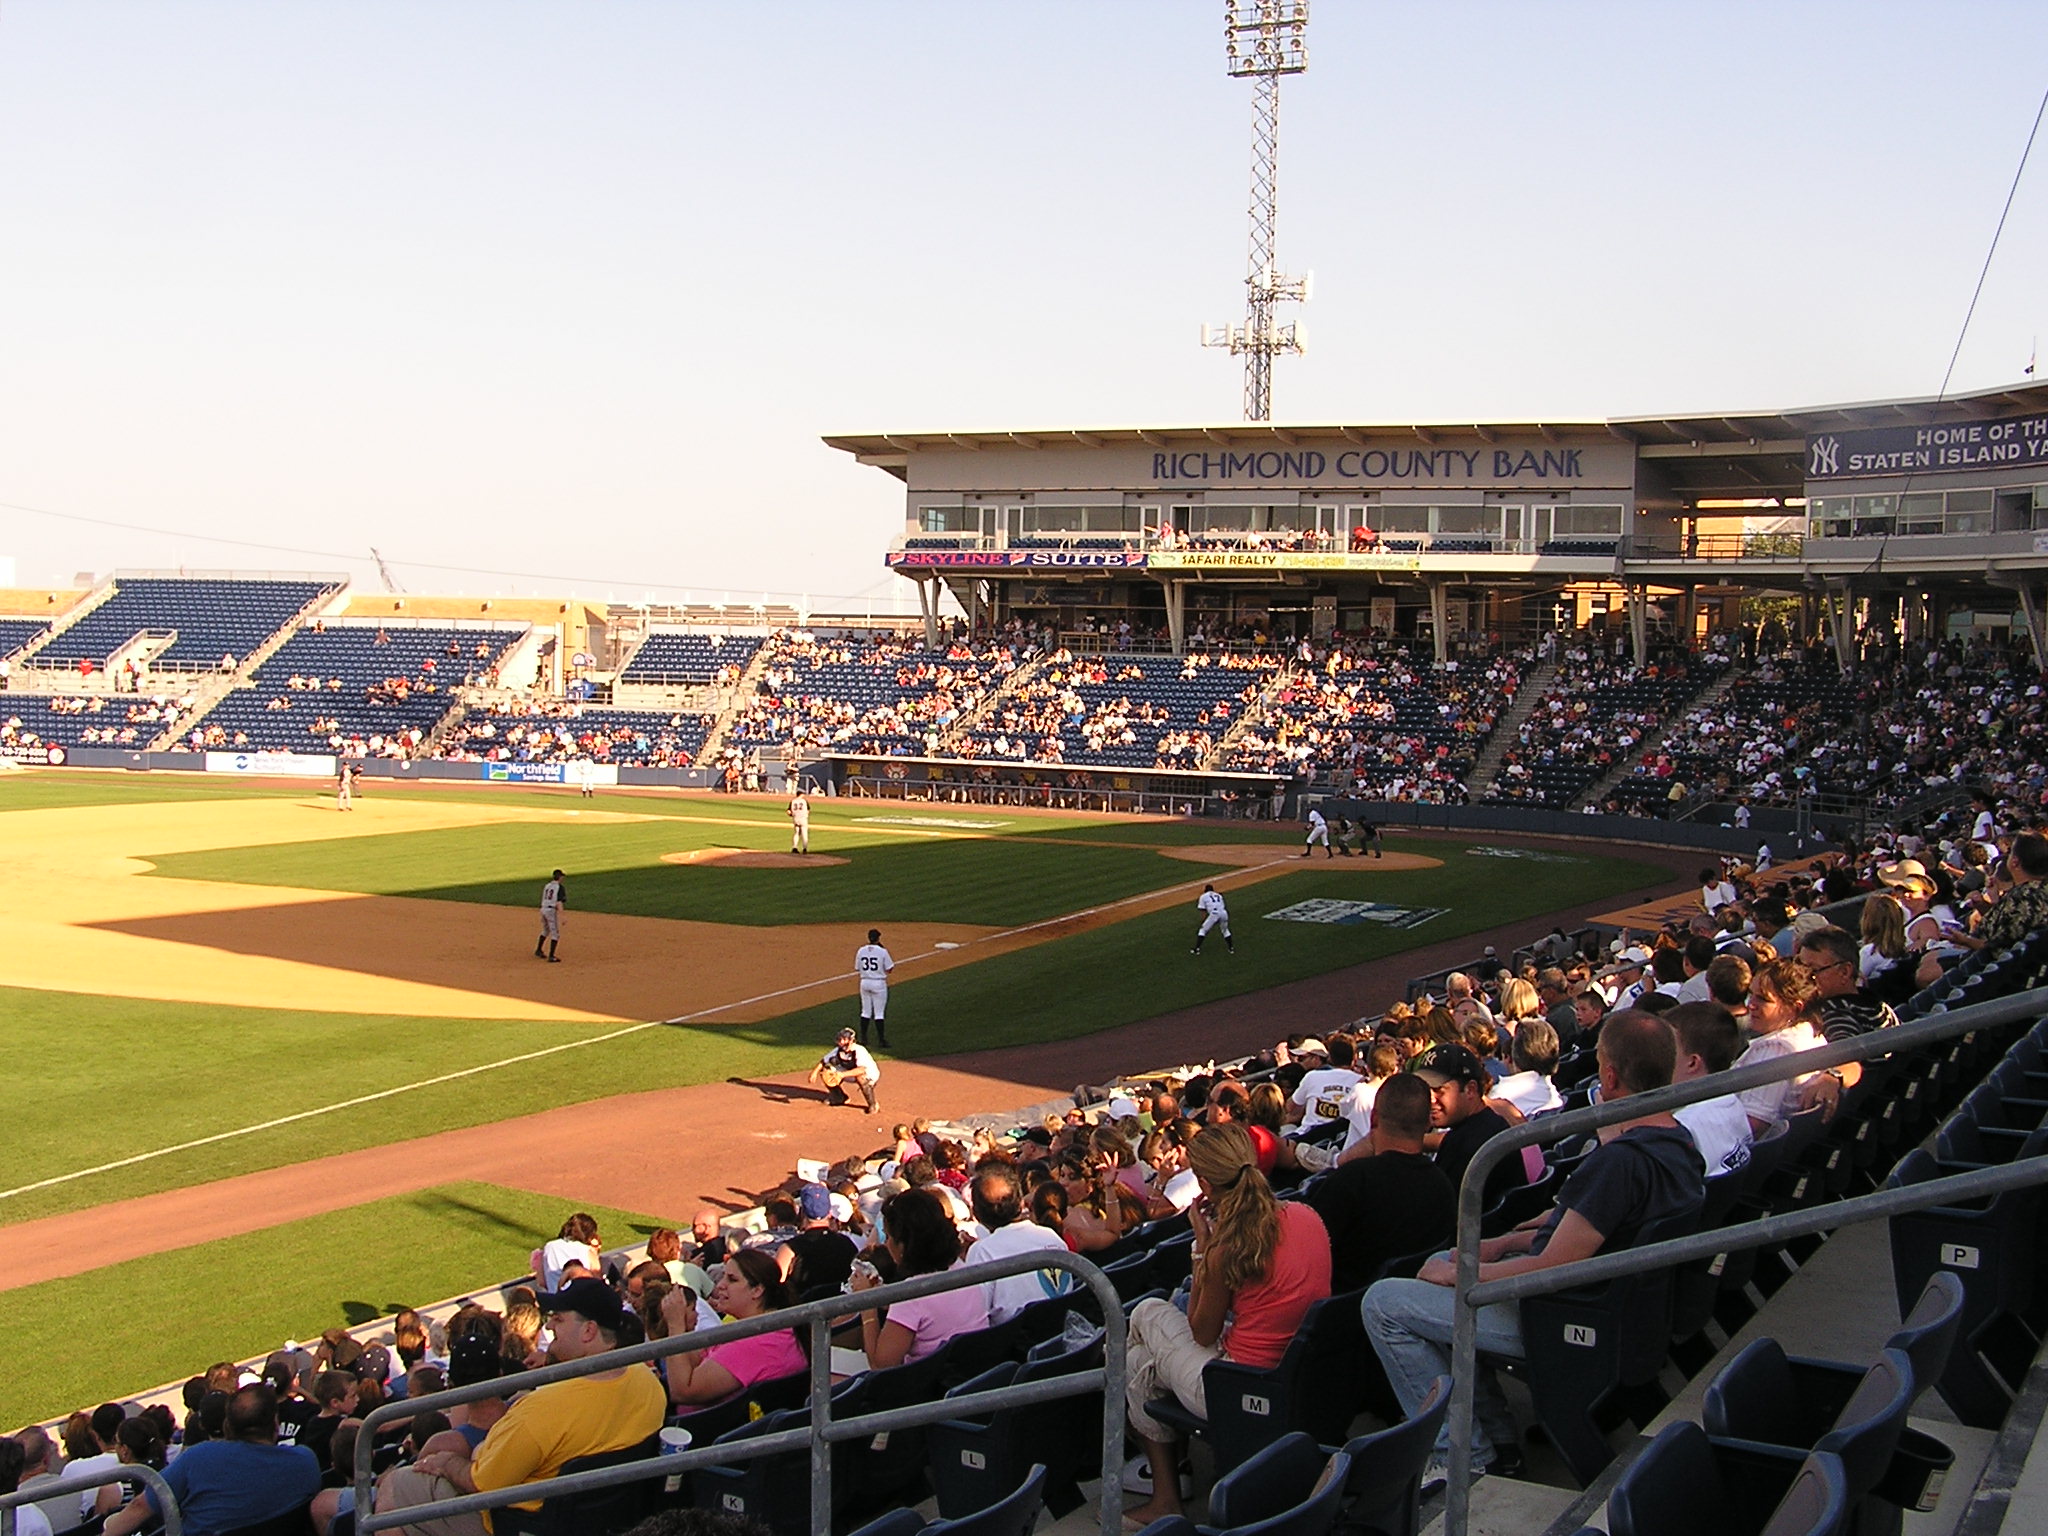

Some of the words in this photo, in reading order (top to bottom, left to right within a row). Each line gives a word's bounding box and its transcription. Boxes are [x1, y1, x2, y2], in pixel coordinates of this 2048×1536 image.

[1916, 426, 1982, 447] HOME
[1989, 423, 2016, 440] OF
[1153, 451, 1326, 479] RICHMOND
[1336, 450, 1480, 478] COUNTY
[1493, 449, 1583, 478] BANK
[1849, 452, 1930, 471] STATEN
[1939, 443, 2021, 465] ISLAND
[906, 553, 1004, 565] SKYLINE
[1031, 553, 1124, 566] SUITE
[1182, 555, 1226, 565] SAFARI
[1229, 555, 1276, 565] REALTY
[508, 762, 561, 775] Northfield
[861, 956, 879, 971] 35
[1954, 1247, 1967, 1263] P
[1573, 1327, 1586, 1343] N
[1249, 1397, 1262, 1412] M
[969, 1453, 978, 1466] L
[729, 1497, 738, 1509] K
